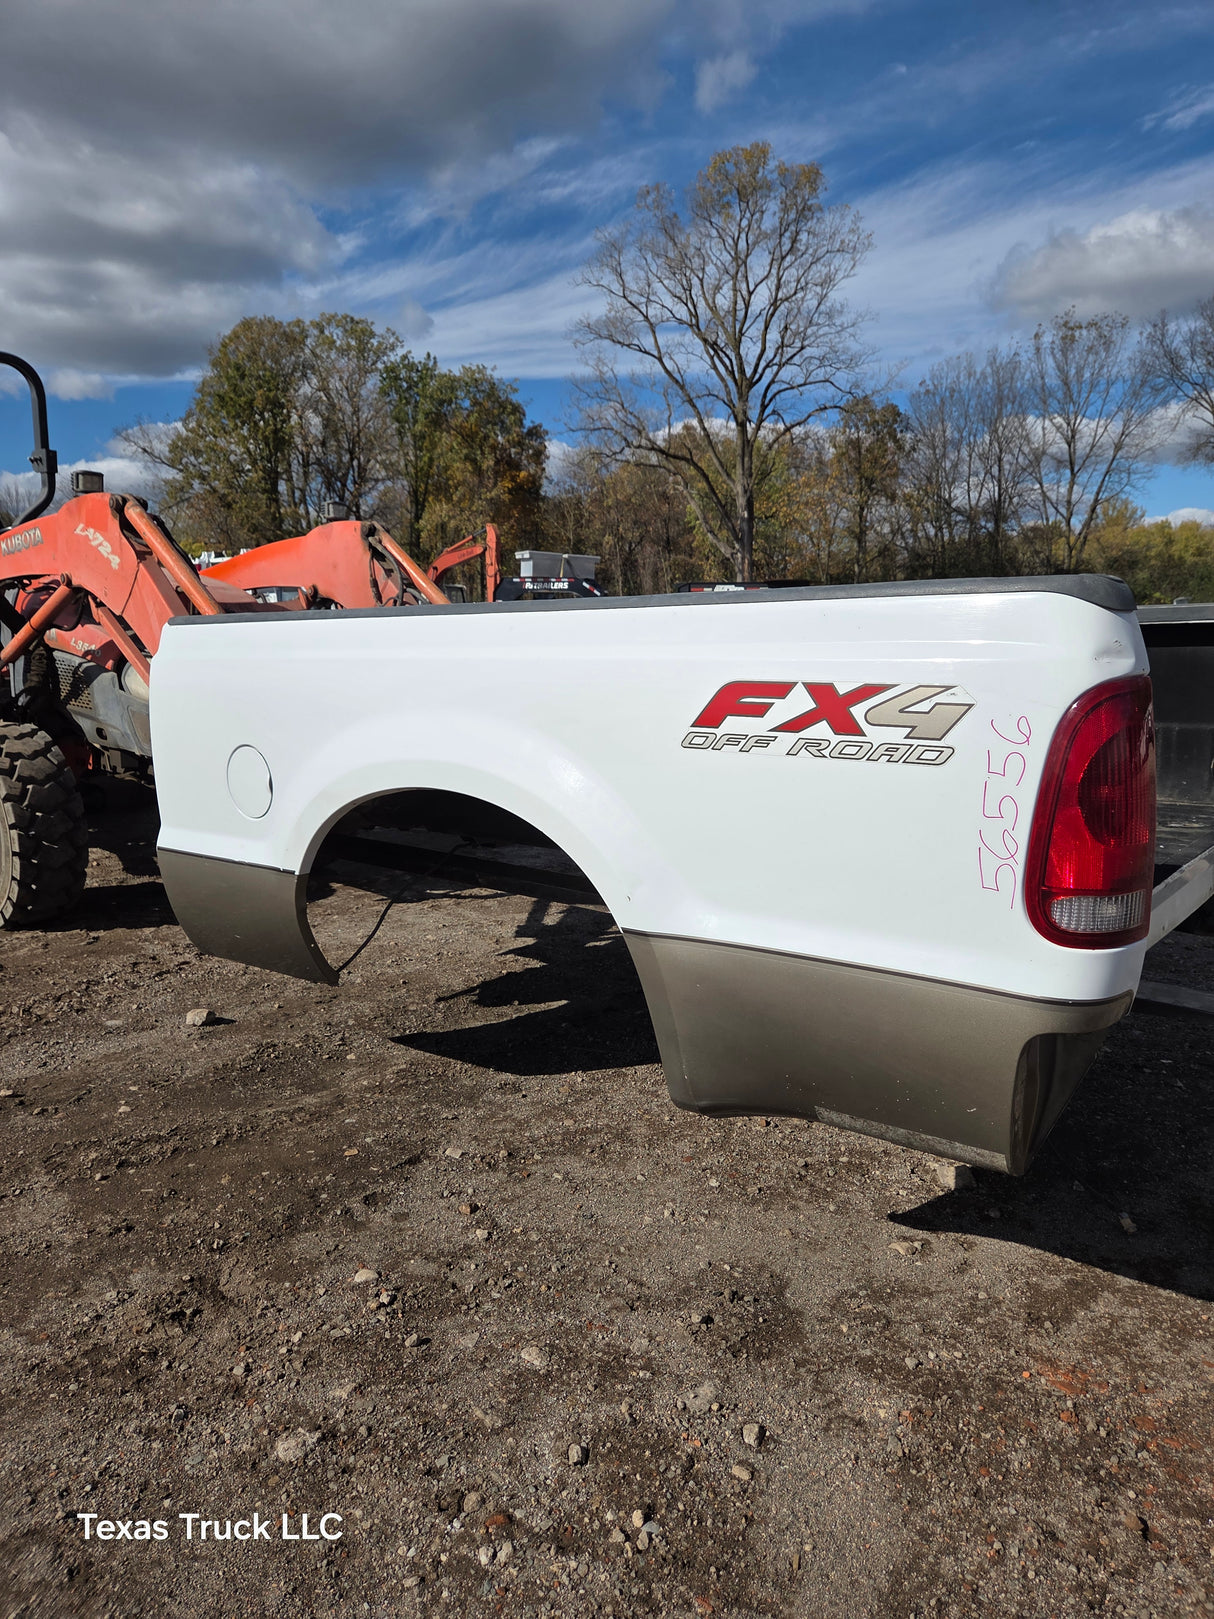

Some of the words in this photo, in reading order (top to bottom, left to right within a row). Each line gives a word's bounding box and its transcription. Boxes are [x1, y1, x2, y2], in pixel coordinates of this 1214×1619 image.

[0, 527, 44, 556] KUBOTA
[74, 523, 121, 570] LA724
[689, 680, 976, 741] FX4
[681, 731, 779, 753] OFF
[786, 738, 956, 766] ROAD
[978, 715, 1032, 909] 56556
